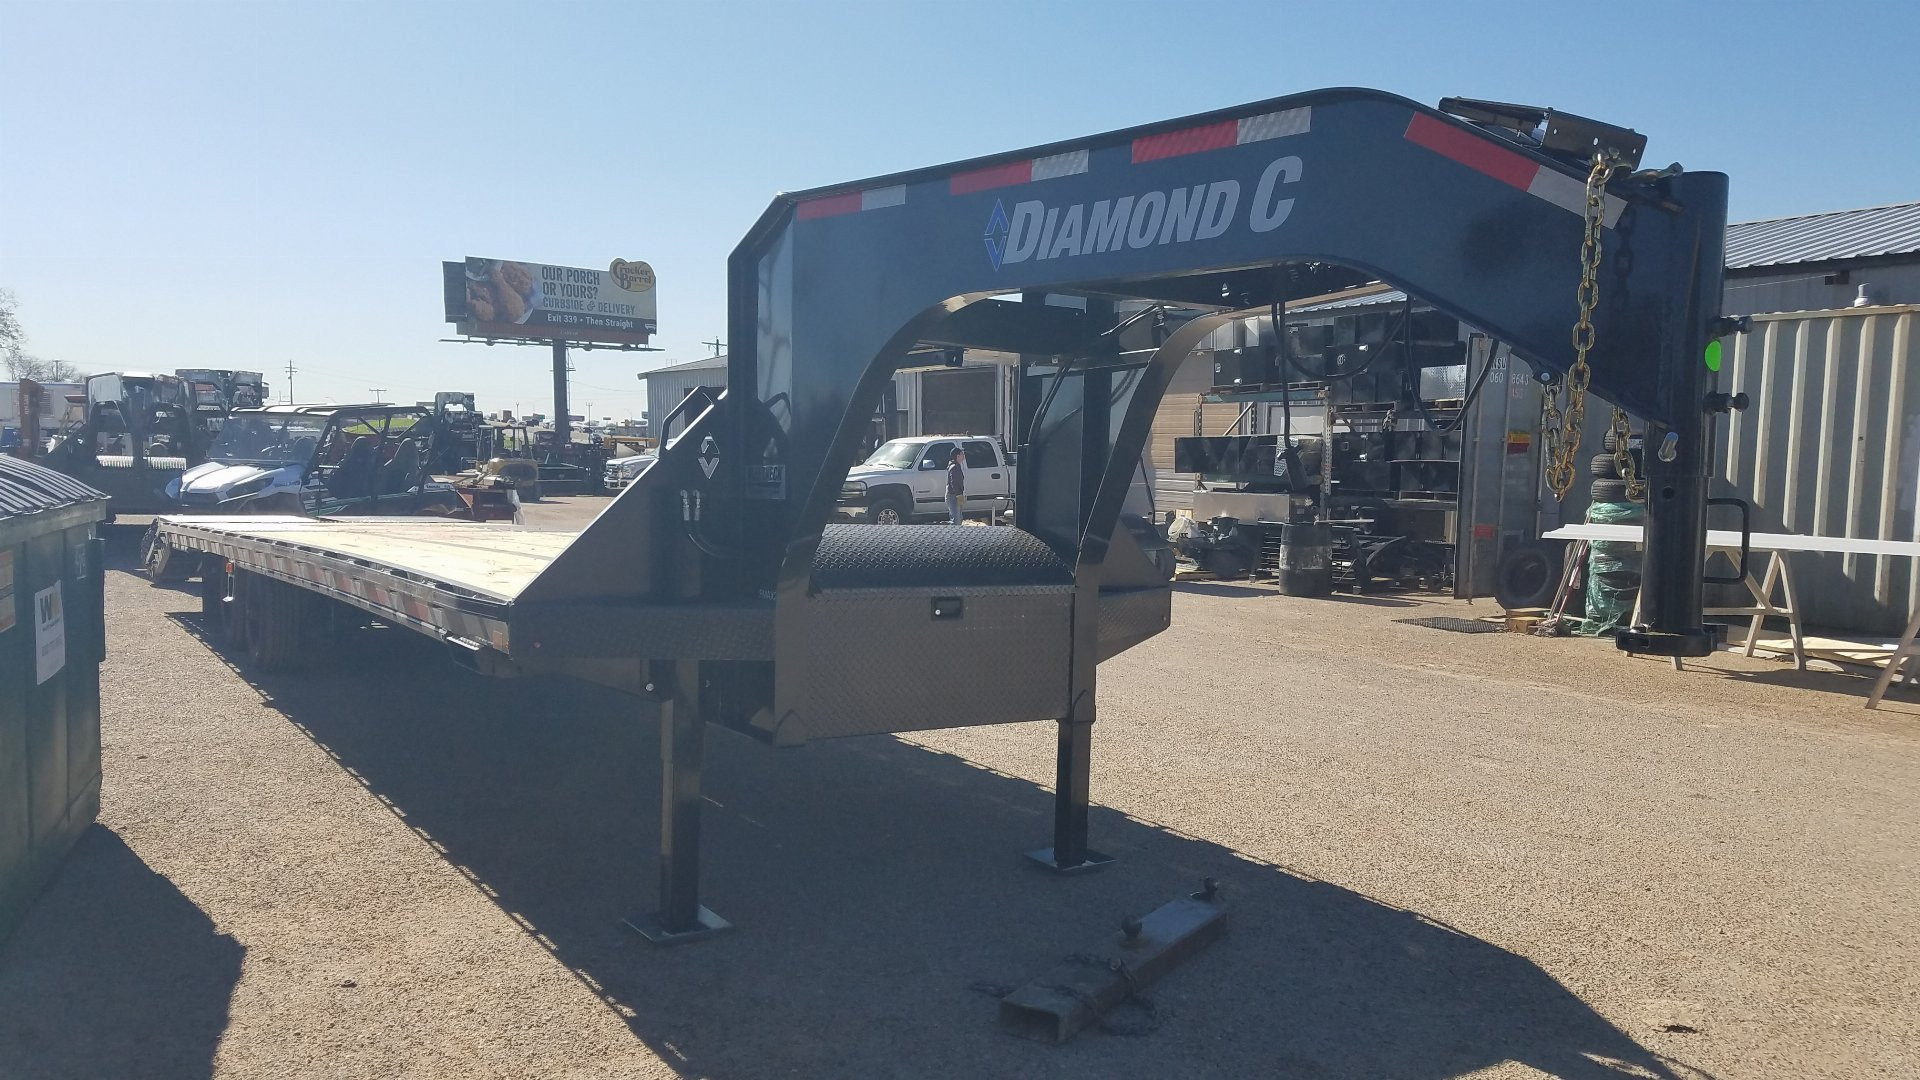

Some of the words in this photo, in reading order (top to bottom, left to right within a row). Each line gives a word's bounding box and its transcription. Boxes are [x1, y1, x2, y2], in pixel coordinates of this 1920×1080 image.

[1002, 179, 1241, 265] DIAMOND
[1250, 155, 1303, 233] C
[541, 266, 563, 281] OUR
[566, 268, 600, 285] PORCH
[542, 281, 557, 296] OR
[559, 283, 598, 300] YOURS?
[543, 297, 585, 311] CURBSIDE
[586, 299, 596, 311] &
[598, 302, 636, 315] DELIVERY
[547, 313, 561, 323] Exit
[563, 314, 577, 324] 339
[585, 316, 604, 327] Then
[605, 318, 633, 330] Straight
